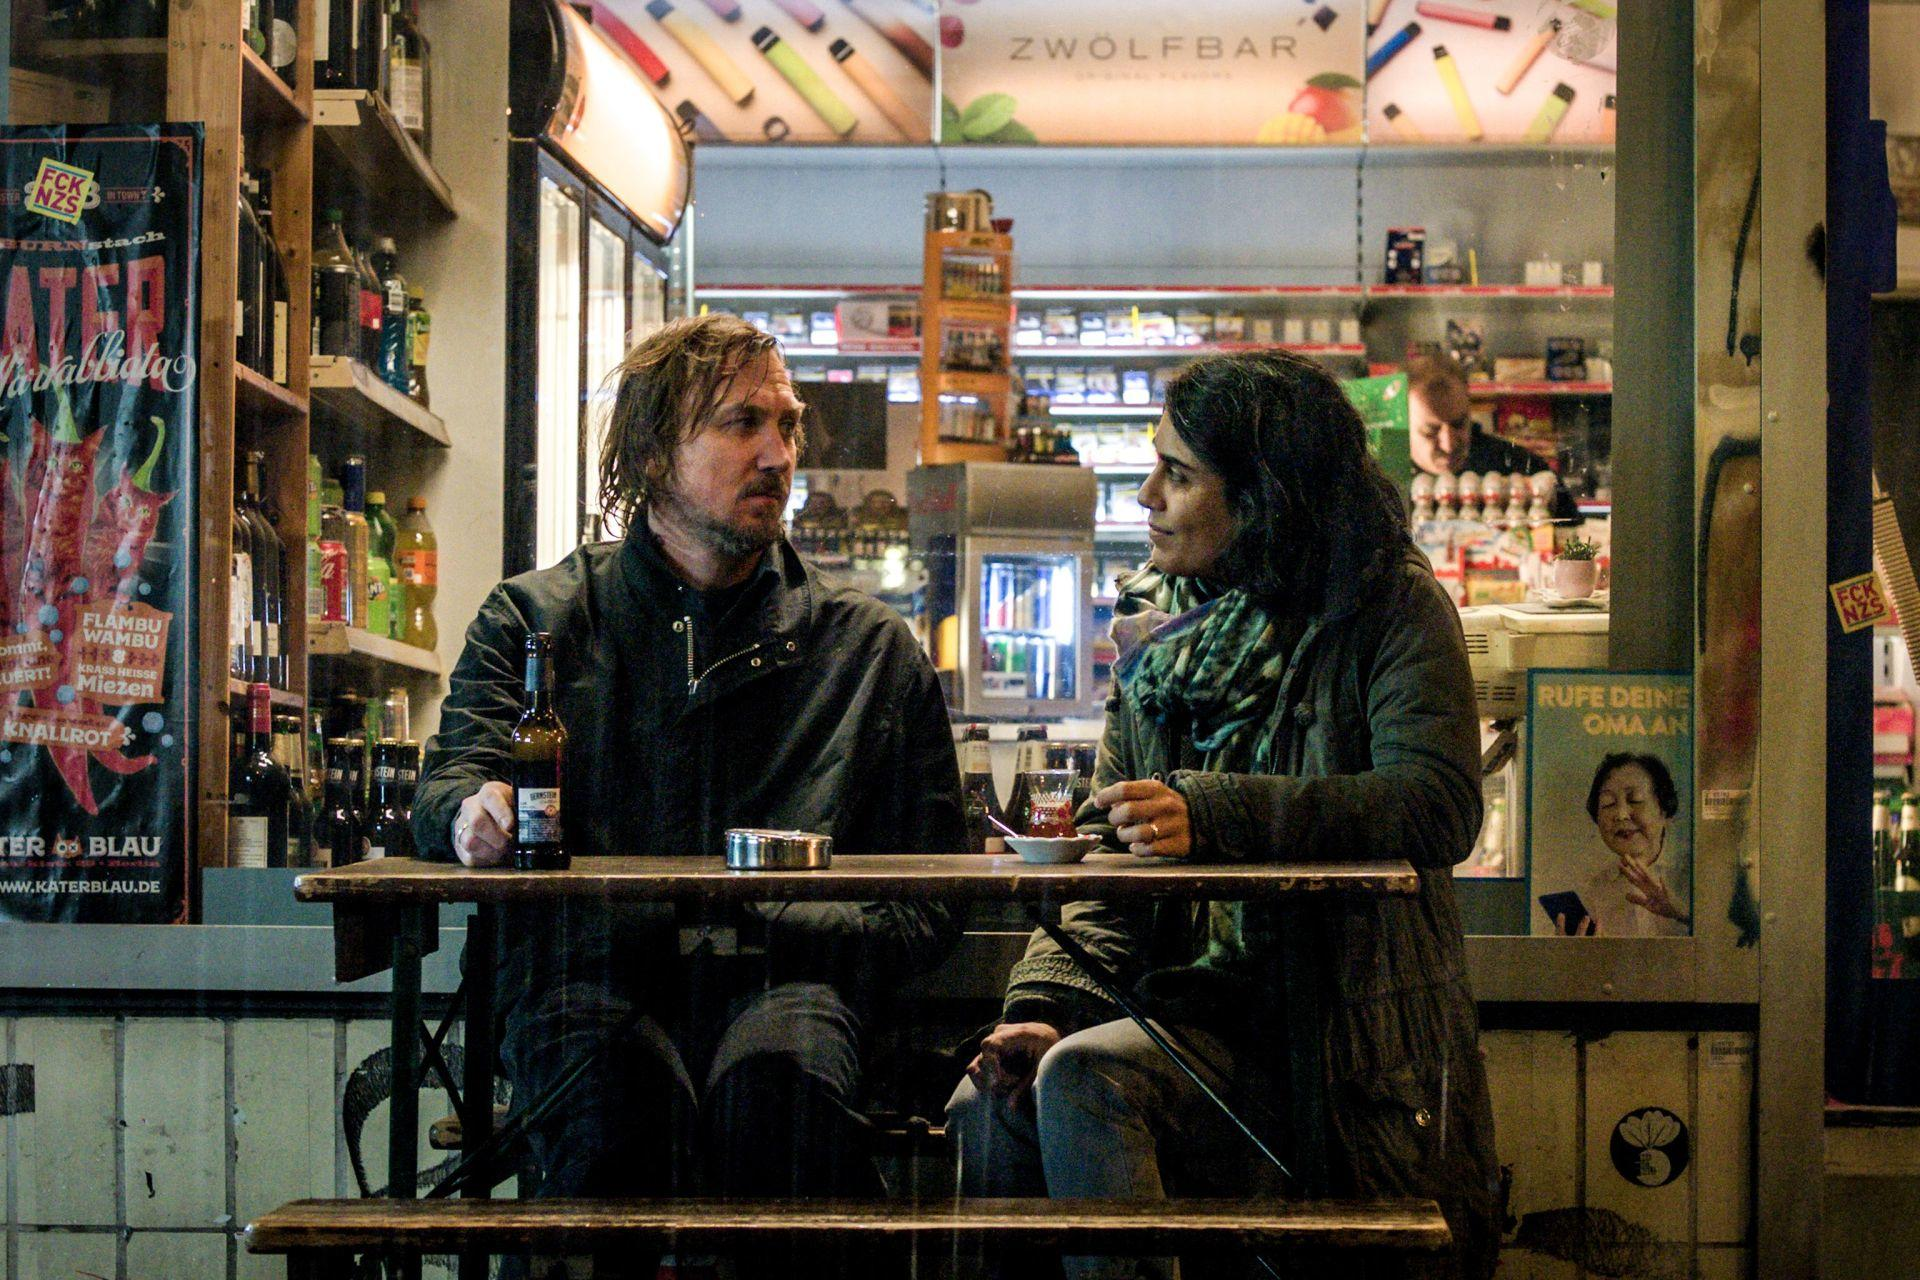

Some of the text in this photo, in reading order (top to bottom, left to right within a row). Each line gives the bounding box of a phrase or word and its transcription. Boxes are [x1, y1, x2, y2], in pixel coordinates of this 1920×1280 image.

[41, 168, 86, 196] FCK
[34, 186, 80, 214] NZS
[1836, 577, 1877, 607] FCK
[82, 612, 162, 634] FLAMBU
[1842, 597, 1885, 626] NZS
[83, 628, 159, 649] WAMBU
[0, 666, 51, 685] UERT!
[77, 663, 158, 680] KRASS HEISSE
[77, 675, 155, 698] Miezen
[1536, 684, 1690, 709] RUFE DEINE
[4, 719, 112, 746] KNALLROT
[1582, 713, 1689, 736] OMA AN
[88, 836, 162, 858] BLAU
